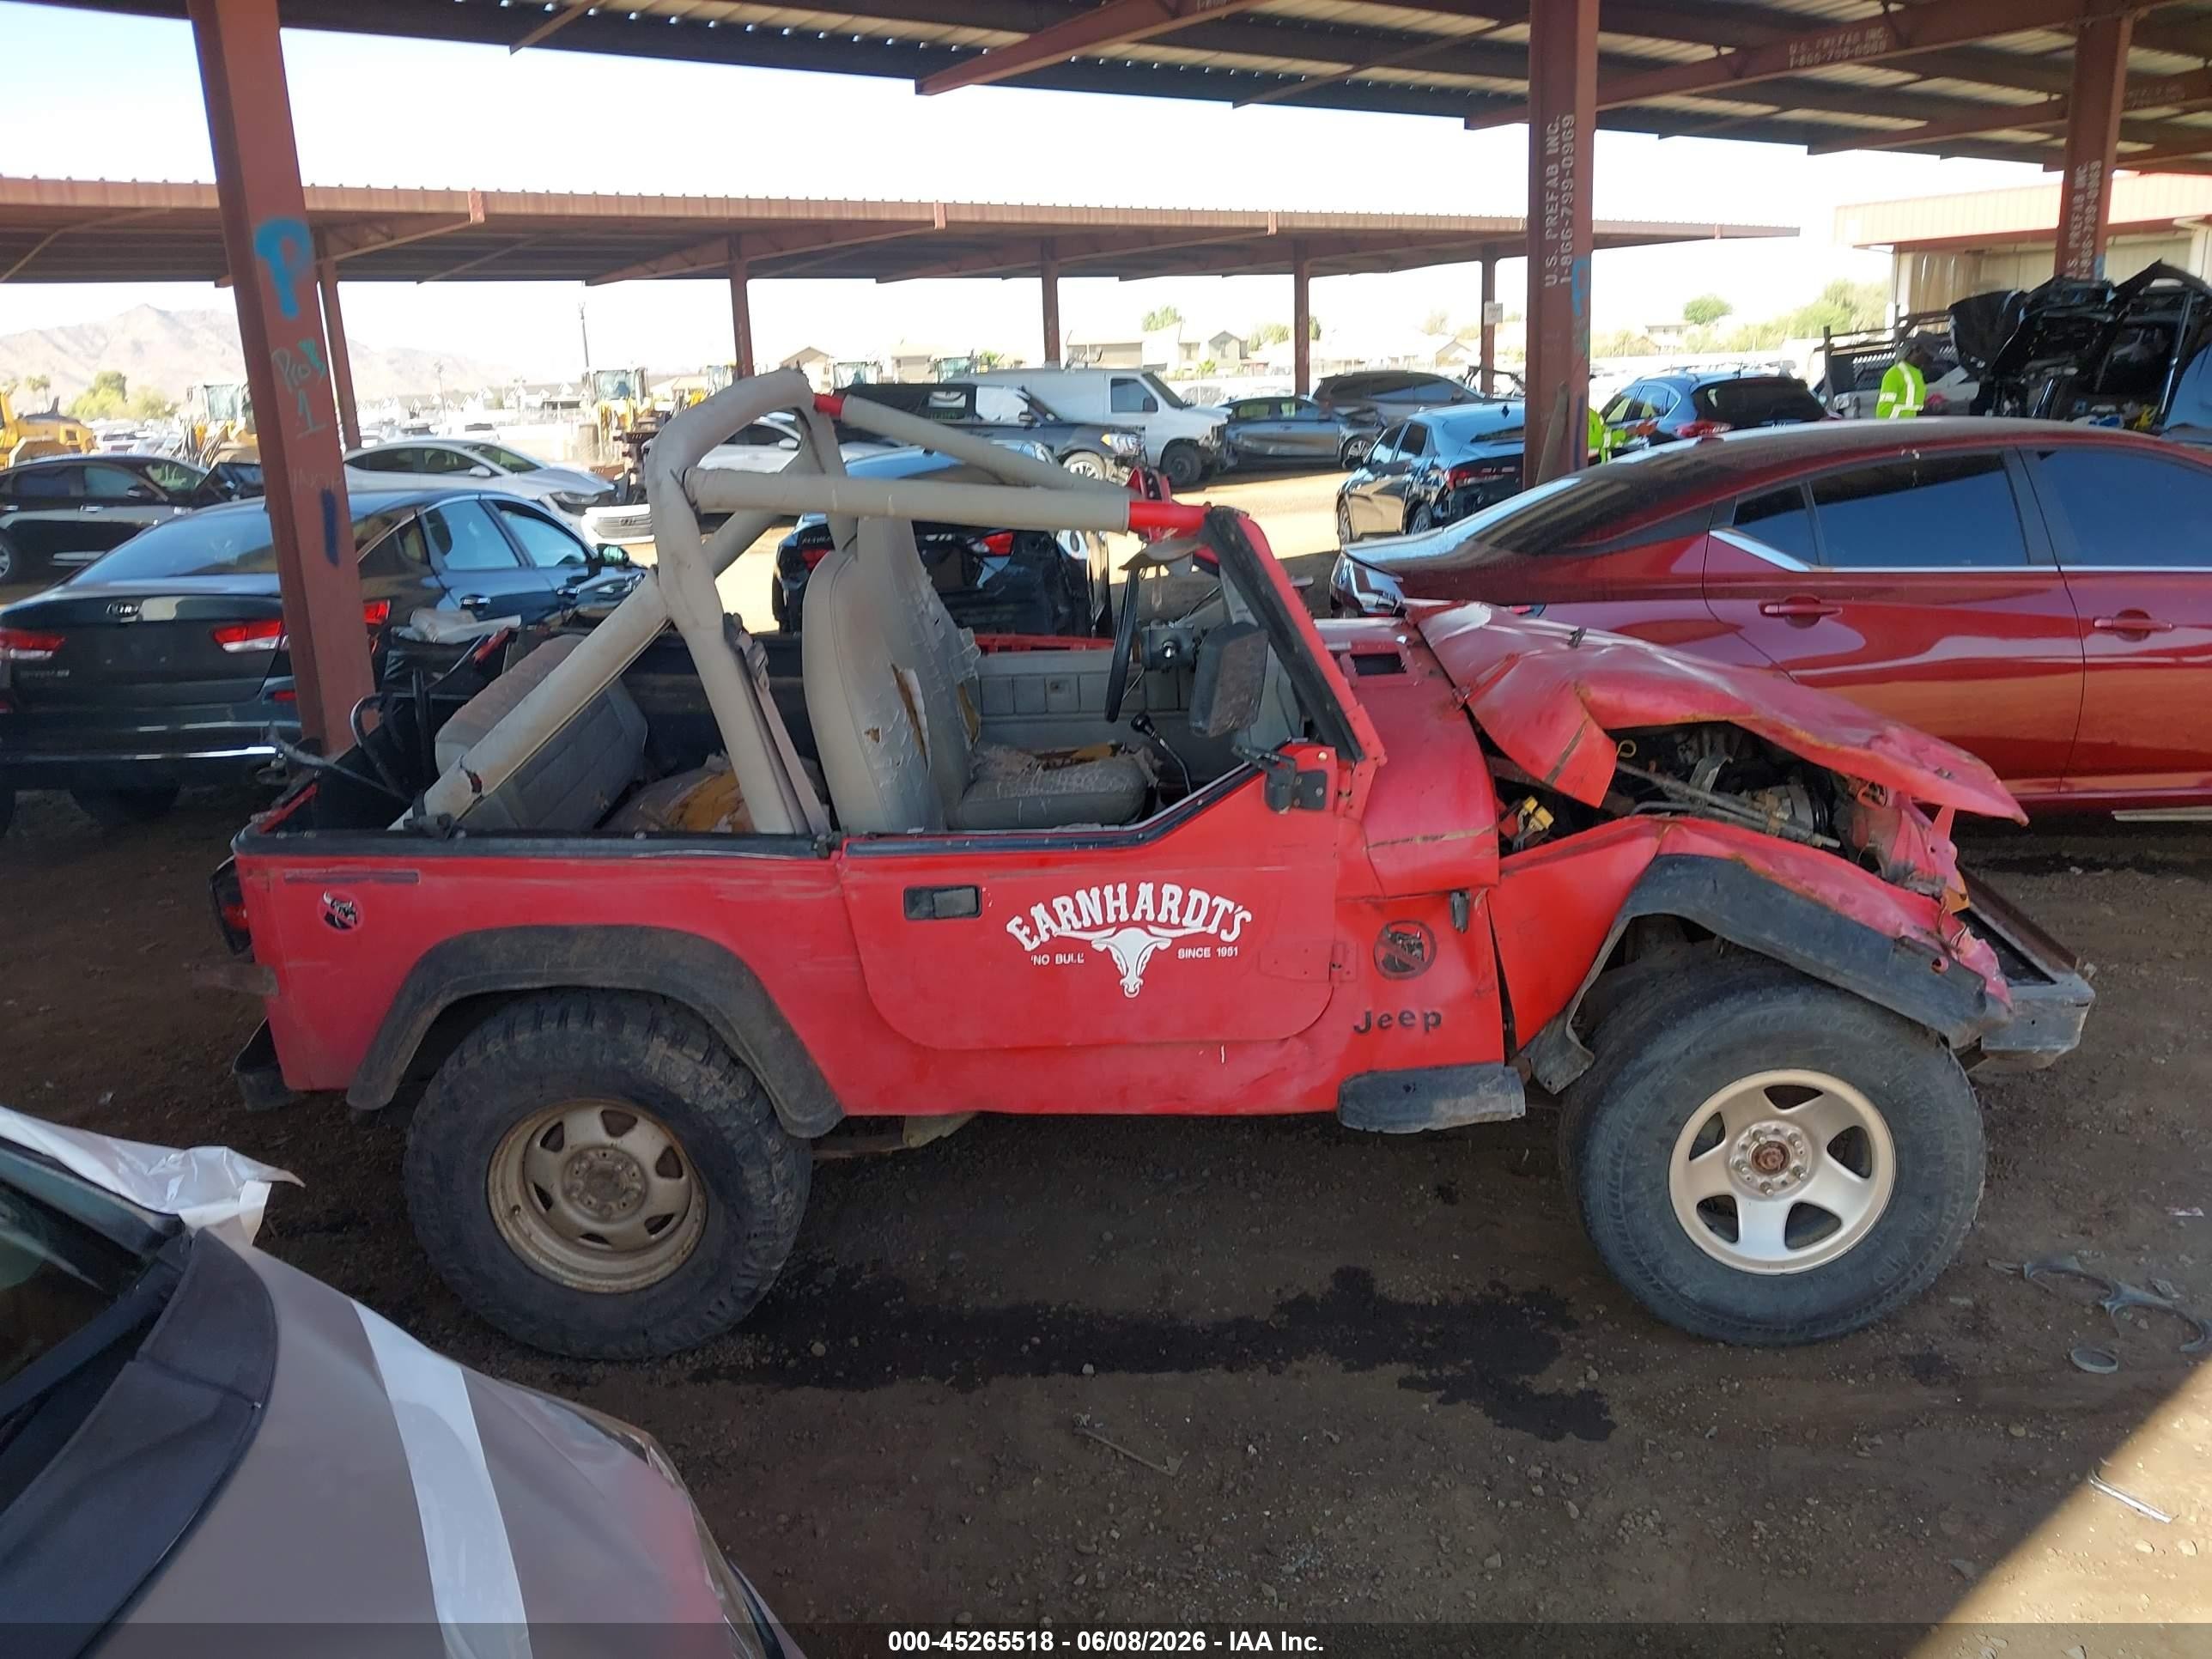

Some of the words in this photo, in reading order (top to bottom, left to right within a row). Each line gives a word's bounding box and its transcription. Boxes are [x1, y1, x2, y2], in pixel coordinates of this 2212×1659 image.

[1547, 114, 1560, 155] INC.
[1546, 163, 1559, 241] PREFAB
[1560, 113, 1575, 285] 1-866-799-0969
[254, 218, 313, 319] P
[1544, 248, 1559, 288] U.S.
[1006, 882, 1252, 951] EARNHARDT'S
[1177, 947, 1211, 959] SINCE
[1354, 1011, 1442, 1034] Jeep
